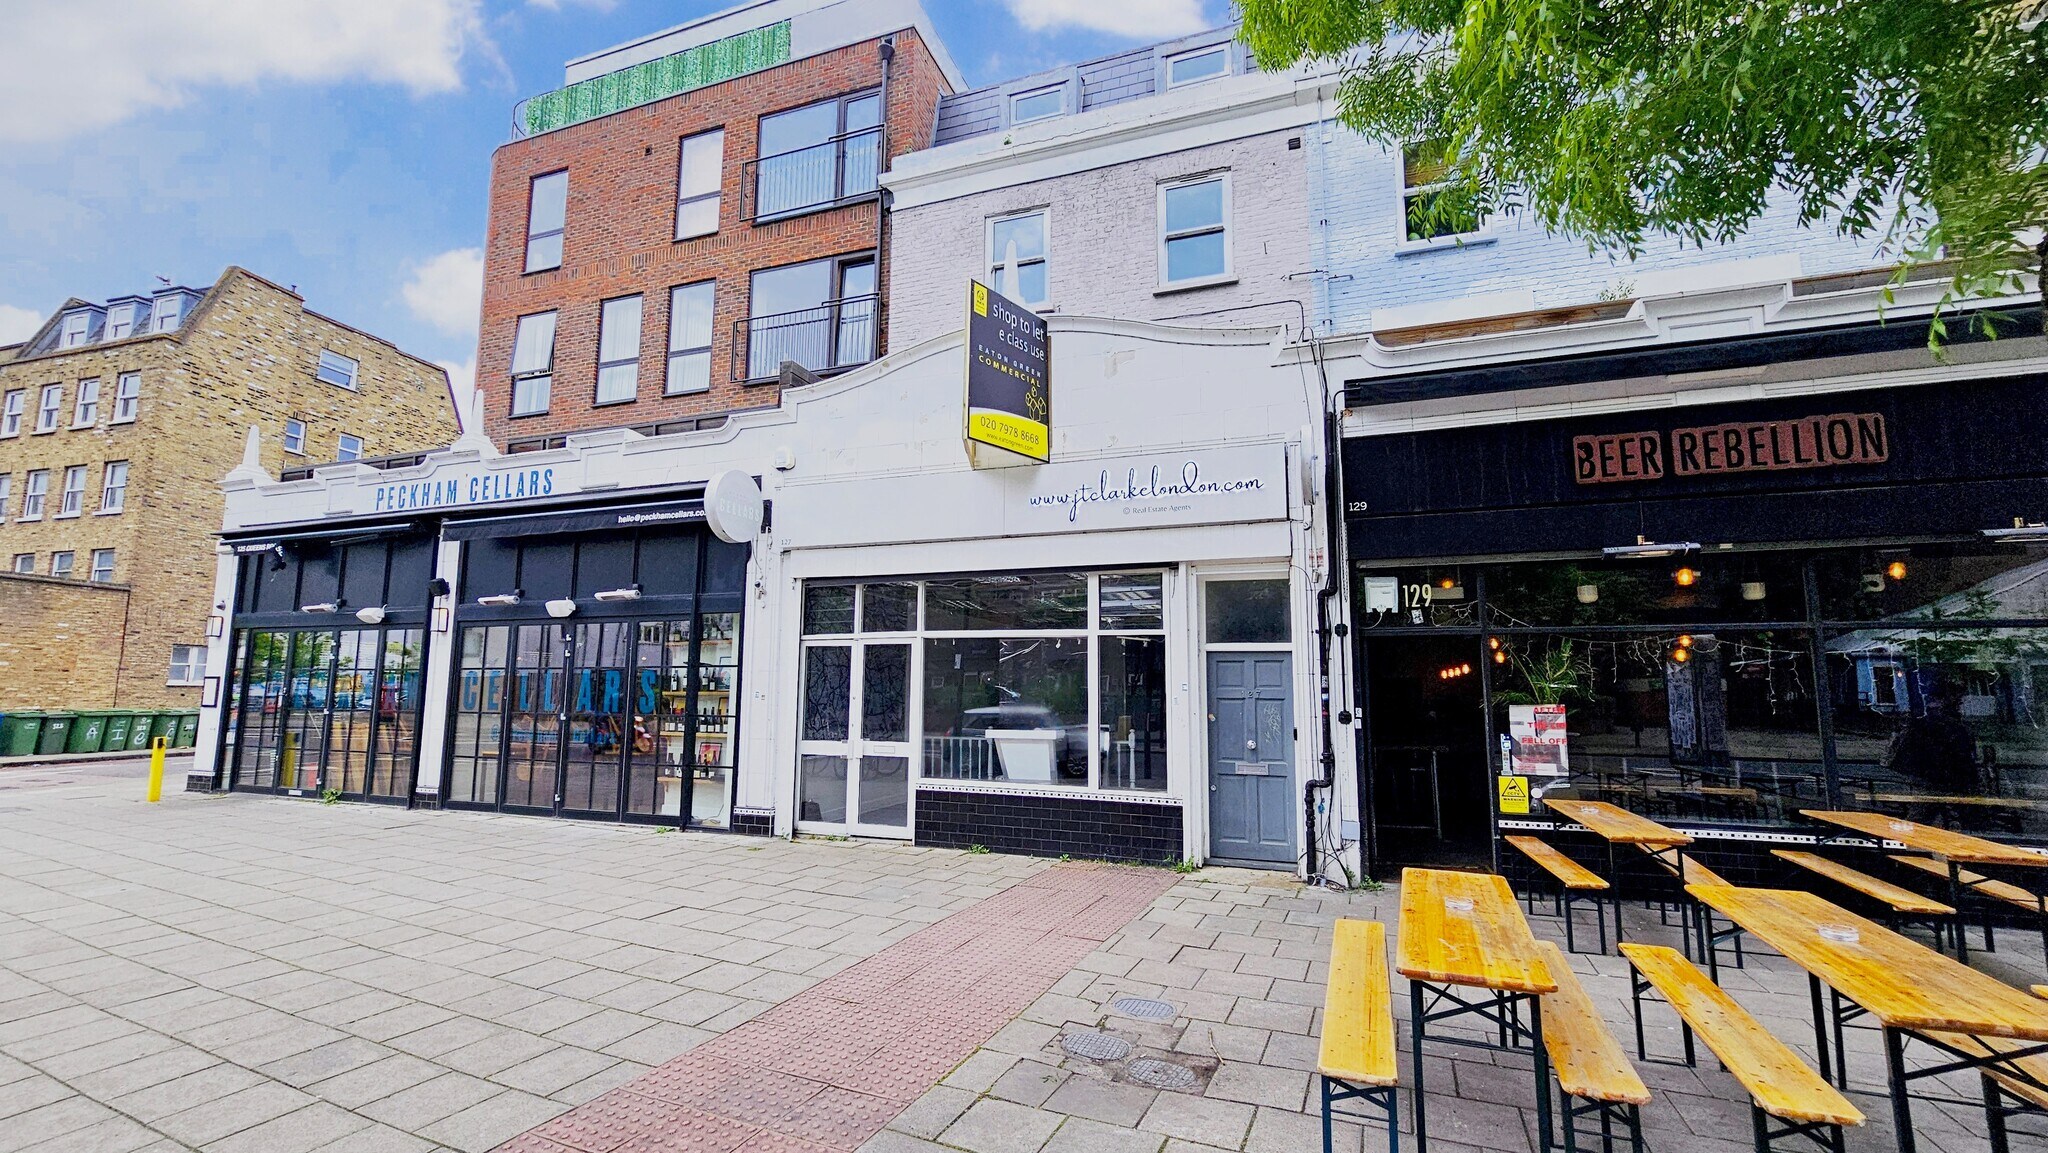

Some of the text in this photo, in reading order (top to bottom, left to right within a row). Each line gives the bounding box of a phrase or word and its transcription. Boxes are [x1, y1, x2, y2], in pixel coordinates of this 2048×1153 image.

[993, 302, 1017, 329] shop
[1020, 317, 1030, 334] to
[1032, 321, 1044, 342] let
[978, 344, 1041, 378] EATON GREEN
[999, 329, 1044, 361] e class use
[978, 355, 1041, 387] COMMERCIAL
[980, 416, 1040, 445] 020 7978 8668
[1575, 416, 1885, 481] BEER REBELLION
[375, 468, 553, 511] PECKHAM CELLARS
[1169, 504, 1192, 513] Agents
[1348, 501, 1368, 512] 129
[1402, 583, 1432, 608] 129
[463, 668, 656, 714] CELLARS
